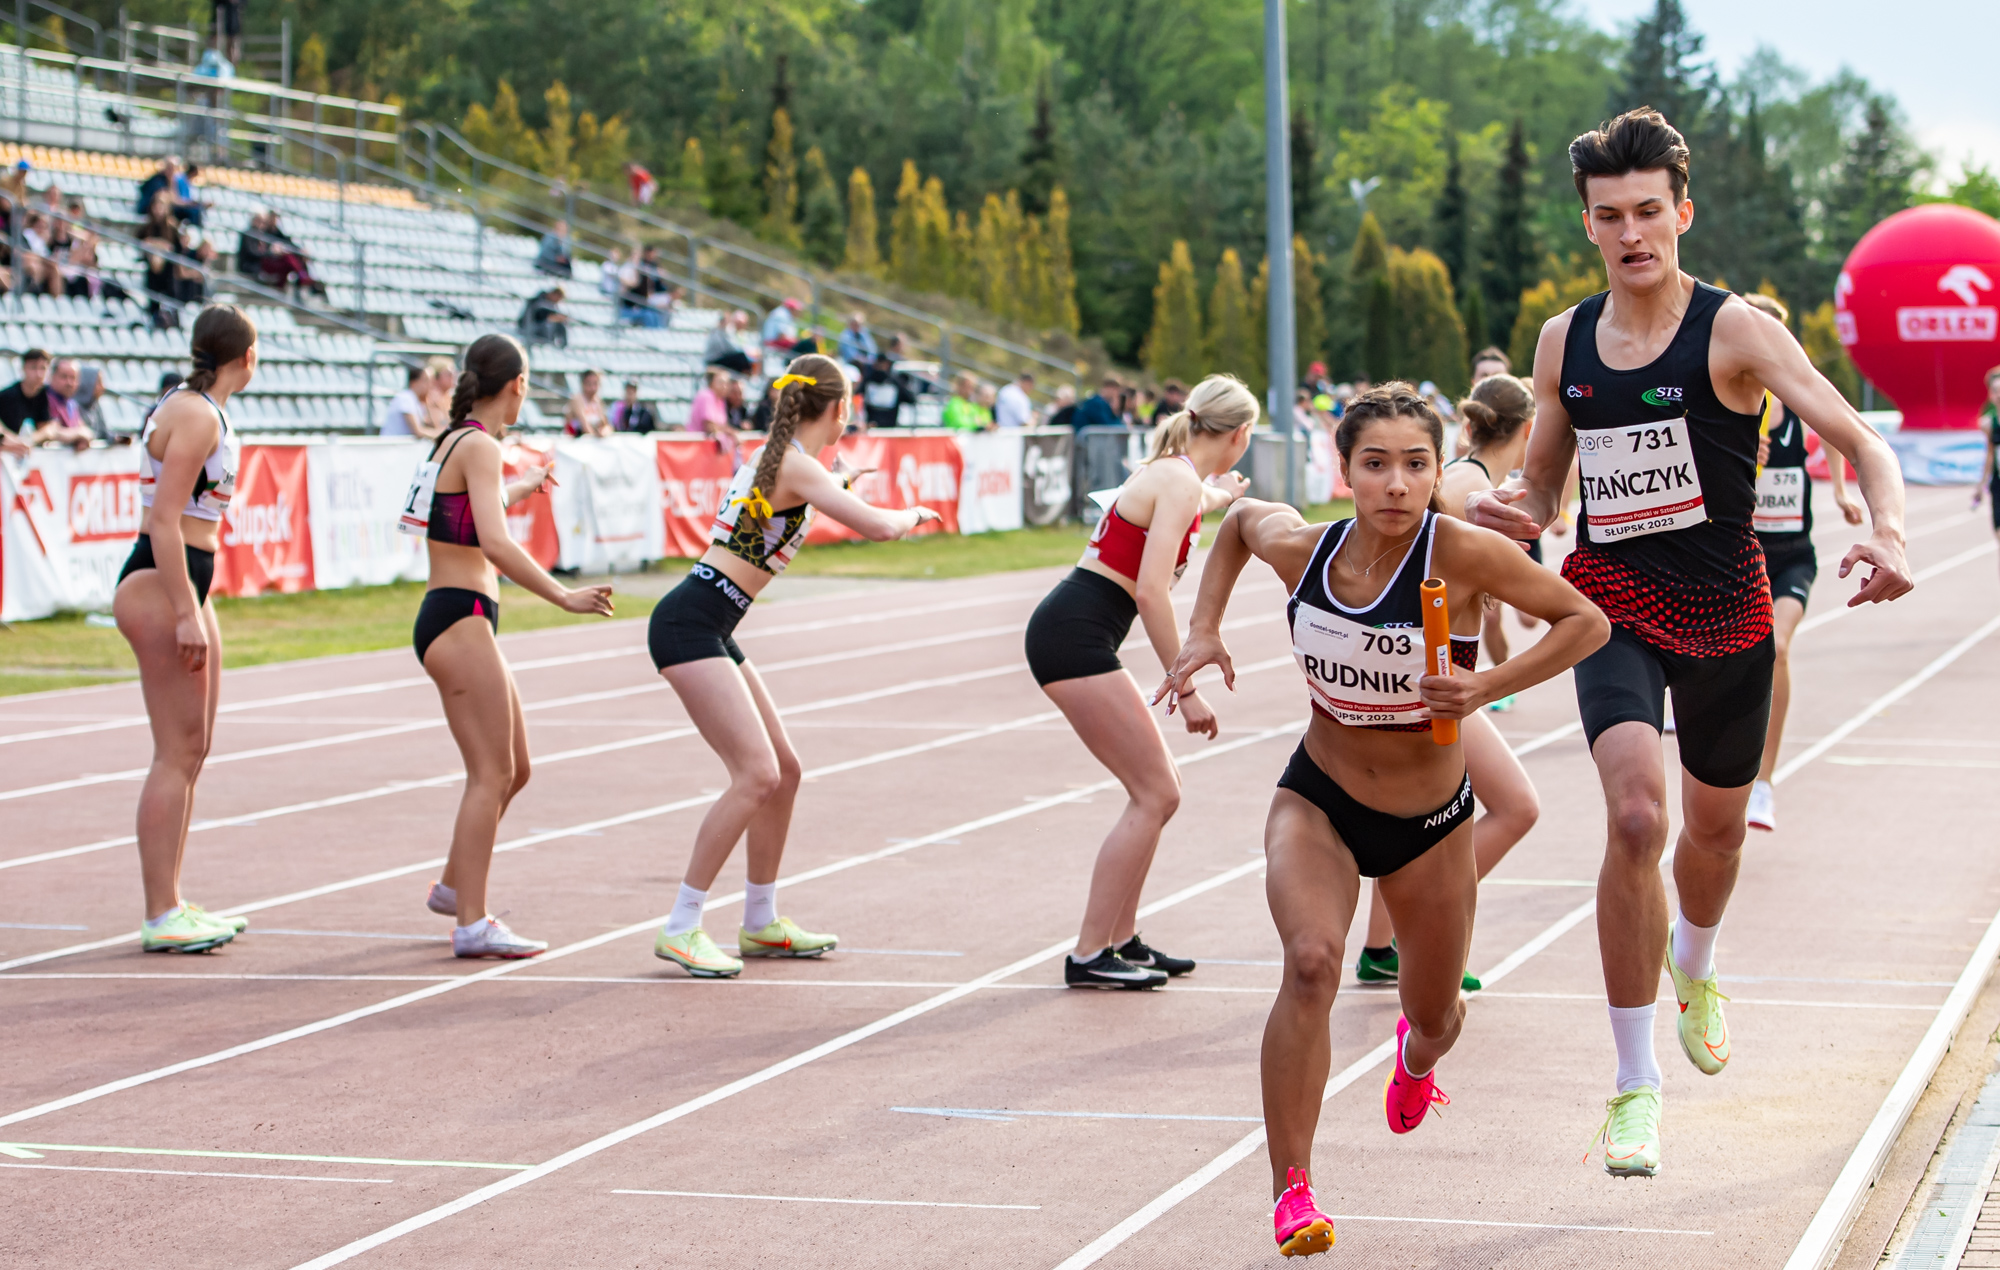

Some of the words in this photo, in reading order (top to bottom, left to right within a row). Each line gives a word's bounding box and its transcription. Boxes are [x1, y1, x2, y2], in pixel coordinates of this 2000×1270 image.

[1906, 315, 1988, 332] ORLEN
[1656, 386, 1683, 397] STS
[1627, 426, 1678, 453] 731
[1773, 472, 1797, 486] 578
[1597, 514, 1633, 523] Mistrzostwa
[1634, 510, 1653, 519] Polski
[1660, 502, 1694, 514] Sztafetach
[1604, 523, 1646, 537] SŁUPSK
[1648, 517, 1675, 529] 2023
[715, 578, 750, 610] NIKE
[1361, 631, 1412, 655] 703
[1303, 653, 1413, 694] RUDNIK
[1327, 704, 1364, 721] SŁUPSK
[1424, 799, 1460, 829] NIKE
